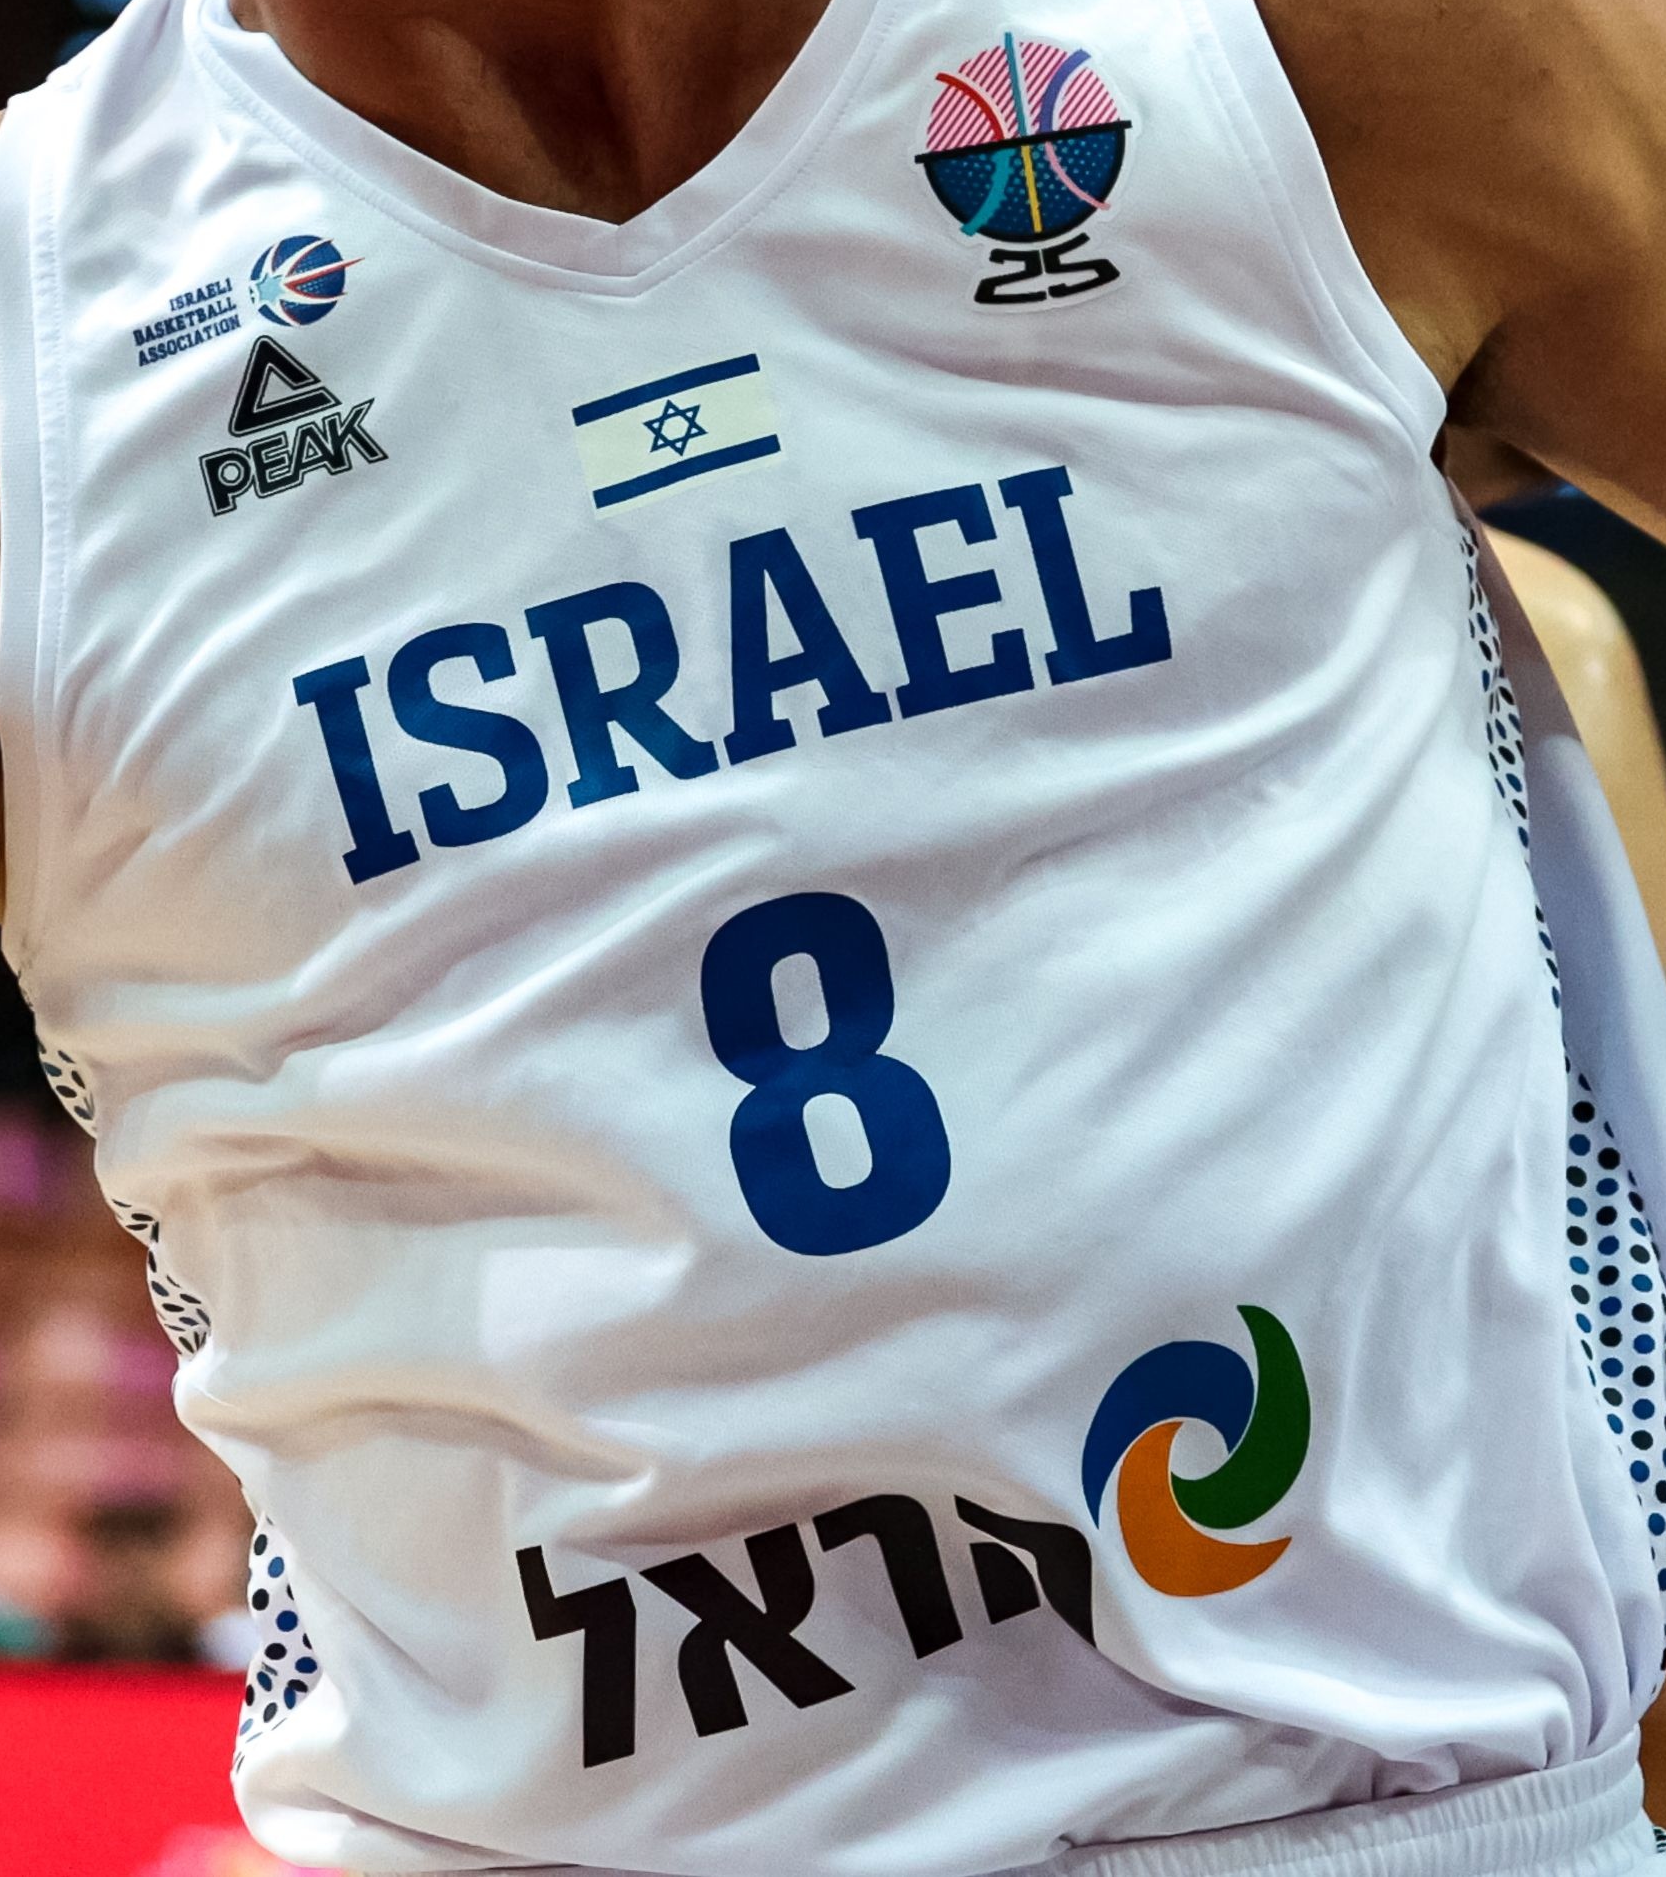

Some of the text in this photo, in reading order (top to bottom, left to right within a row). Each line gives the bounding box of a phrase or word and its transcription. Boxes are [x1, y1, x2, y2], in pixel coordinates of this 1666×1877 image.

[169, 277, 233, 312] ISRAELI
[973, 232, 1121, 305] 25
[132, 296, 238, 347] BASKETBALL
[138, 313, 242, 367] ASSOCIATION
[198, 397, 389, 517] PEAK
[292, 464, 1173, 886] ISRAEL
[700, 891, 952, 1257] 8
[515, 1493, 1096, 1768] הראל
